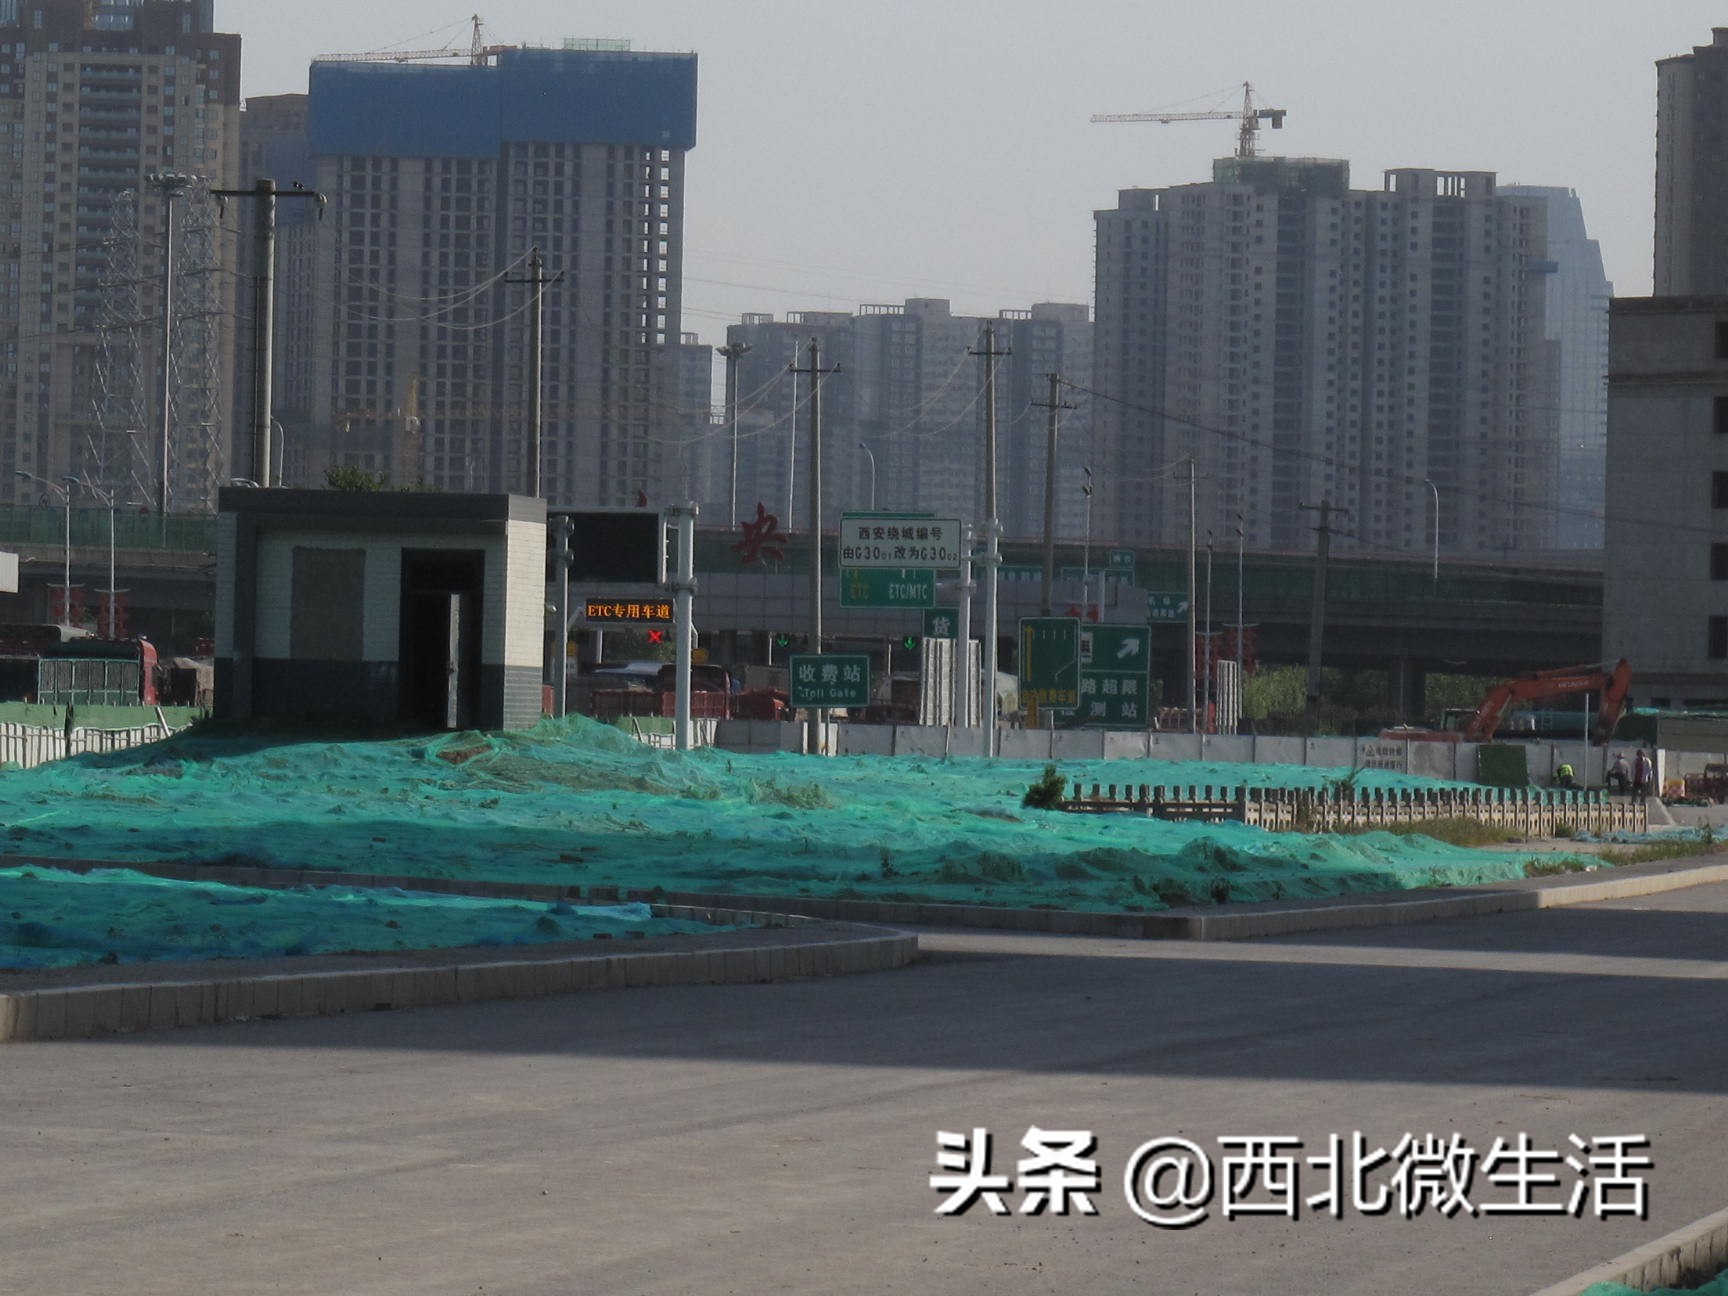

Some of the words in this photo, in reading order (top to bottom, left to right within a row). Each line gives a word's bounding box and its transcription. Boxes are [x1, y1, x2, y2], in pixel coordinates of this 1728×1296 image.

[857, 525, 943, 541] 西安绕城编号
[586, 603, 672, 620] ETC专用车道
[799, 664, 861, 684] 收费站
